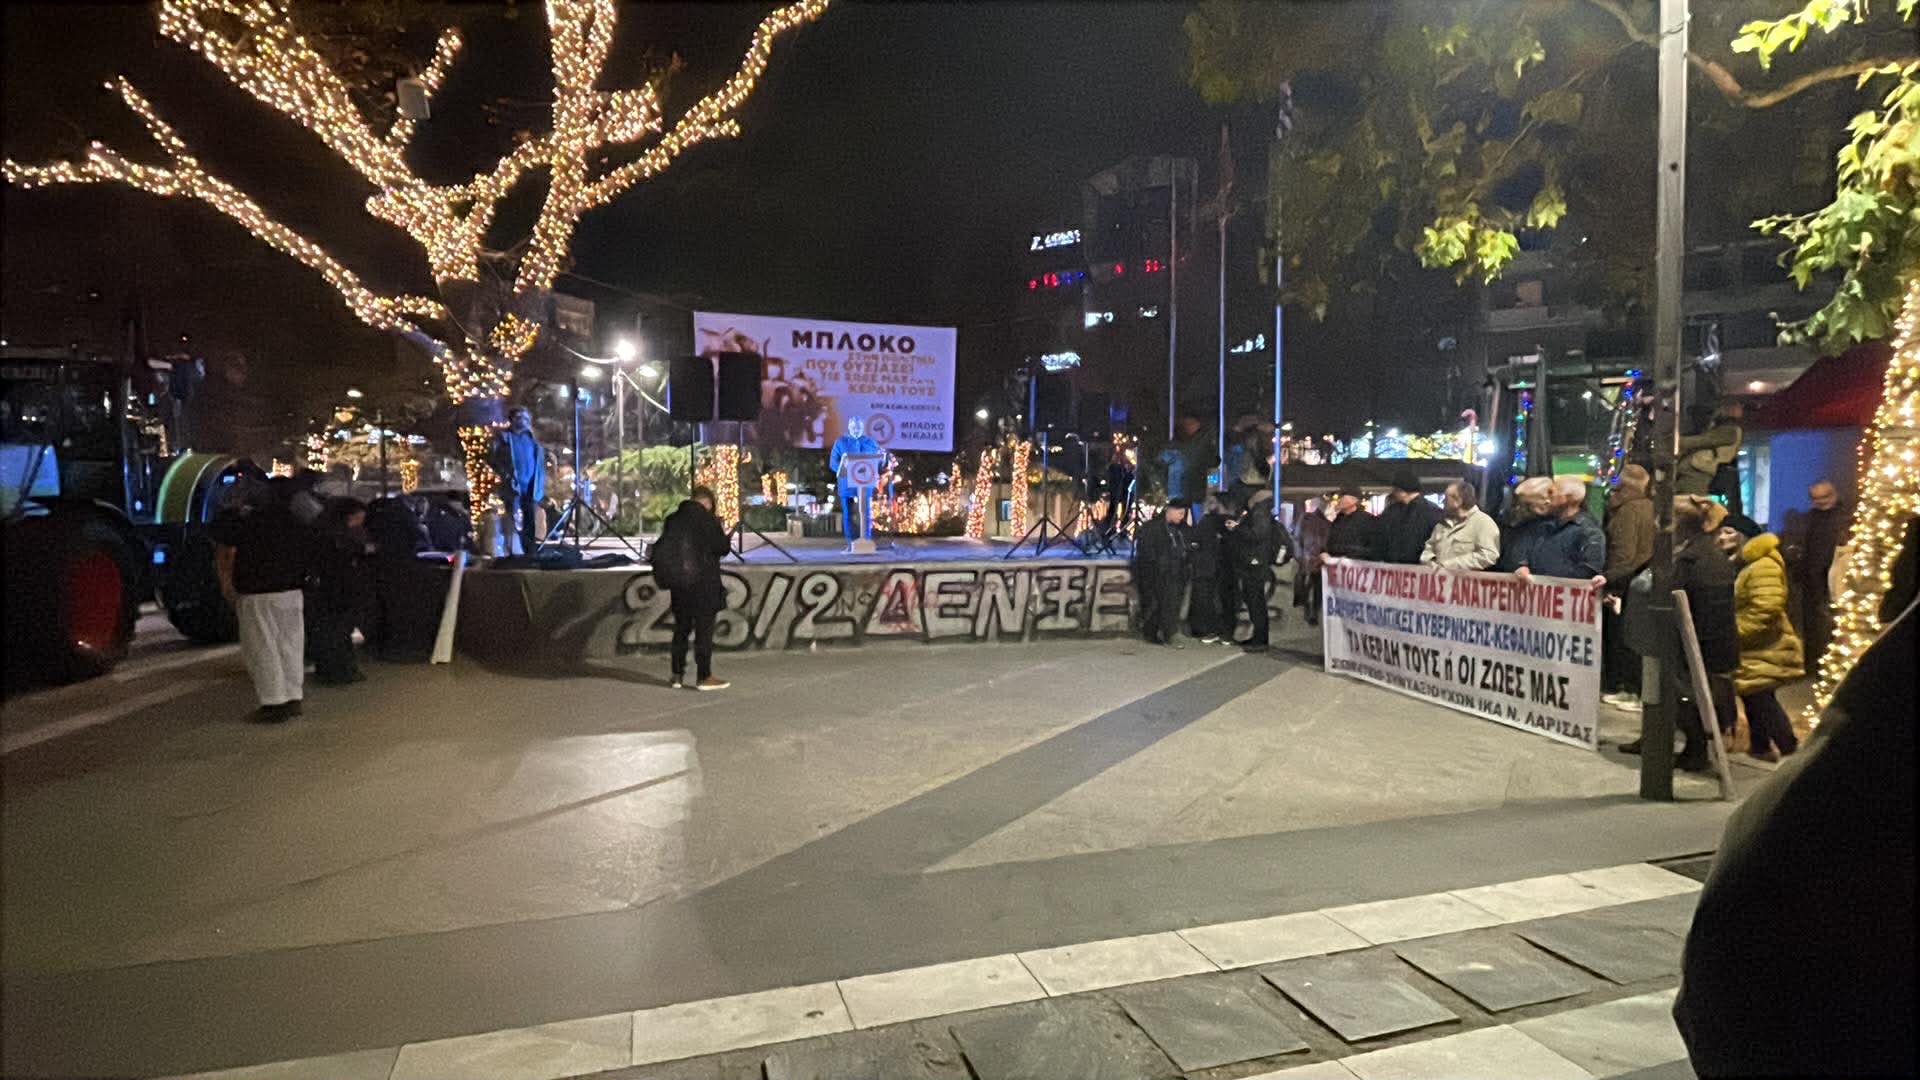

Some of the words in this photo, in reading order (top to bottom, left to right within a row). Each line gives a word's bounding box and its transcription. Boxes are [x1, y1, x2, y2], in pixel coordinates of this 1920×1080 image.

[792, 330, 915, 353] ΜΠΛΟΚΟ
[806, 359, 836, 369] ΠΟΥ
[848, 384, 896, 395] ΚΕΡΔΗ
[901, 386, 937, 397] ΤΟΥΣ
[901, 422, 945, 430] ΜΠΛΟΚΟ
[864, 567, 1031, 641] ΔΕΝ
[1341, 566, 1370, 593] ΤΟΥΣ
[1370, 569, 1416, 600] ΑΓΩΝΕΣ
[1418, 572, 1447, 604] ΜΑΣ
[1450, 575, 1564, 621] ΑΝΑΤΡΕΠΟΥΜΕ
[1570, 586, 1597, 625] ΤΙΣ
[1361, 633, 1401, 668] ΚΕΡΔΗ
[1402, 643, 1441, 679] ΤΟΥΣ
[1458, 655, 1476, 687] ΟΙ
[1480, 659, 1525, 699] ΖΩΕΣ
[1530, 669, 1570, 711] ΜΑΣ
[1478, 698, 1502, 717] ΙΚΑ
[1506, 707, 1521, 722] Ν.
[1525, 711, 1593, 744] ΛΑΡΙΣΑΣ
